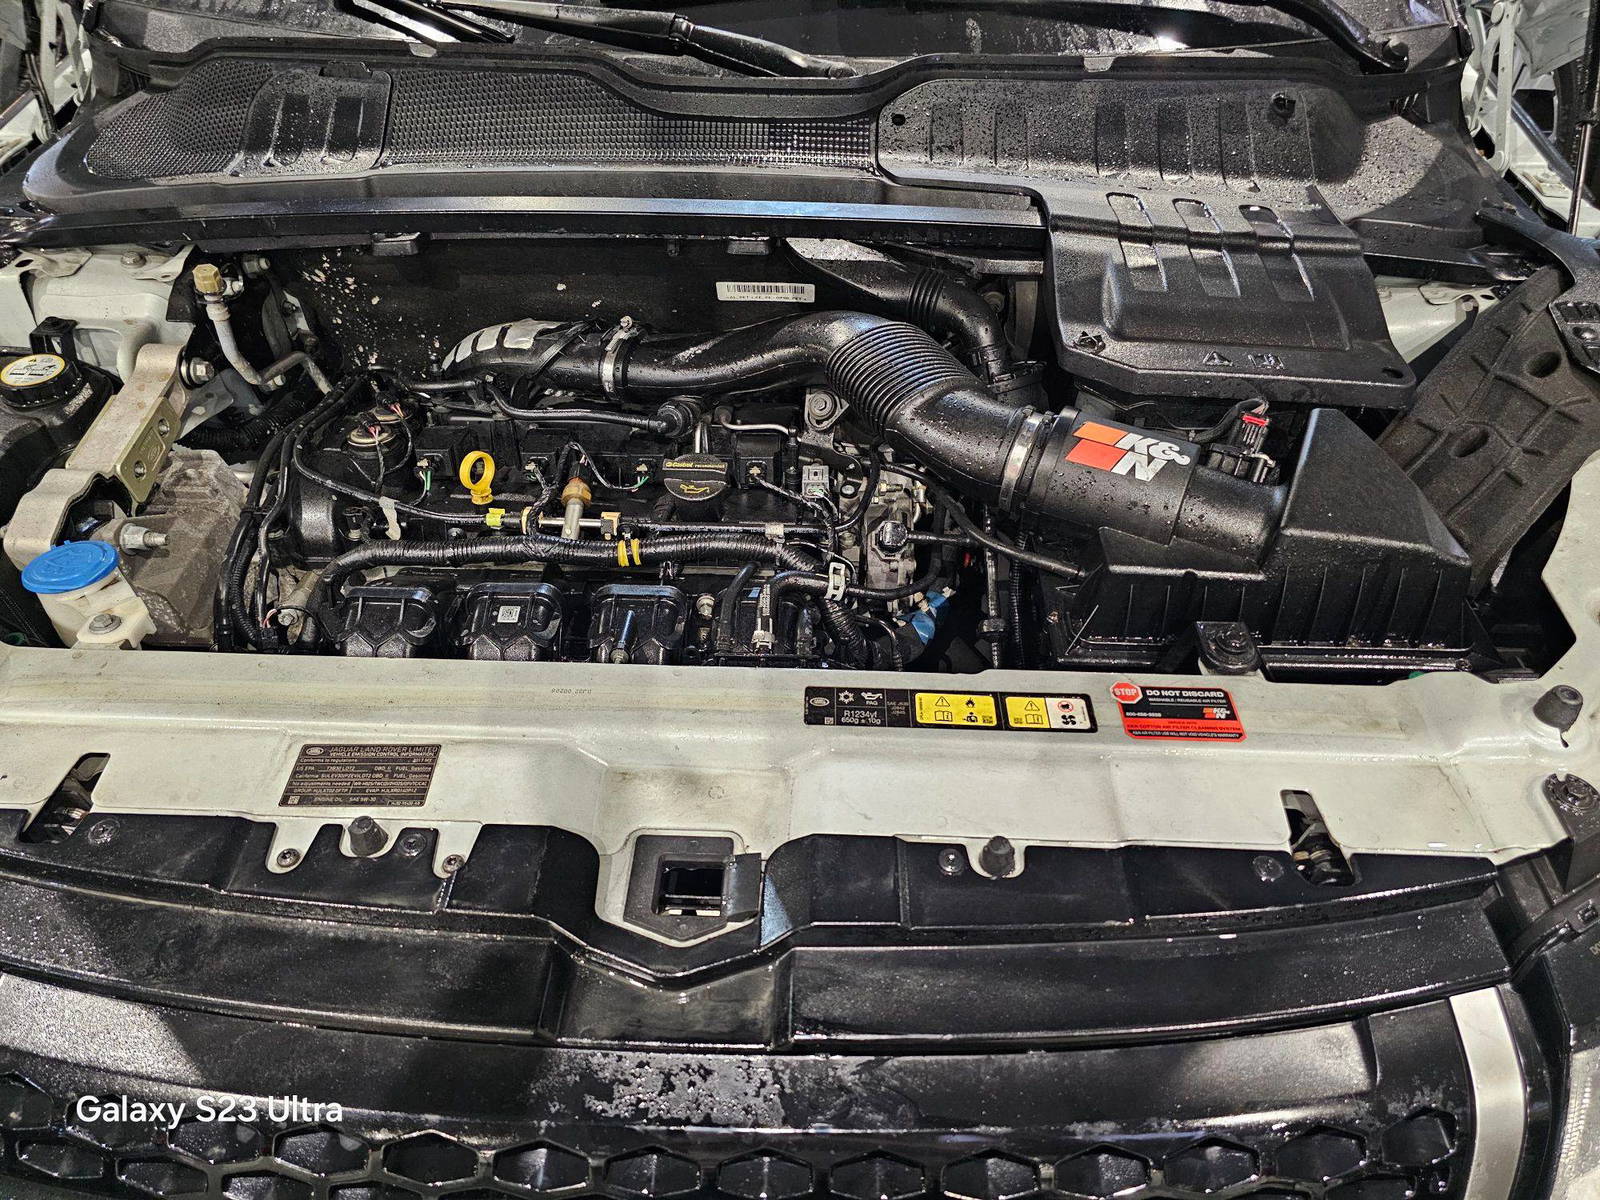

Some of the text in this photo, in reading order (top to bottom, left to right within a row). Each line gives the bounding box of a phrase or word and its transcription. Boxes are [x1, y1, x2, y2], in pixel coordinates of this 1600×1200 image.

[1113, 432, 1191, 482] K&N
[1113, 688, 1137, 696] STOP
[1182, 690, 1225, 698] DISCARD
[1213, 707, 1231, 719] K&N
